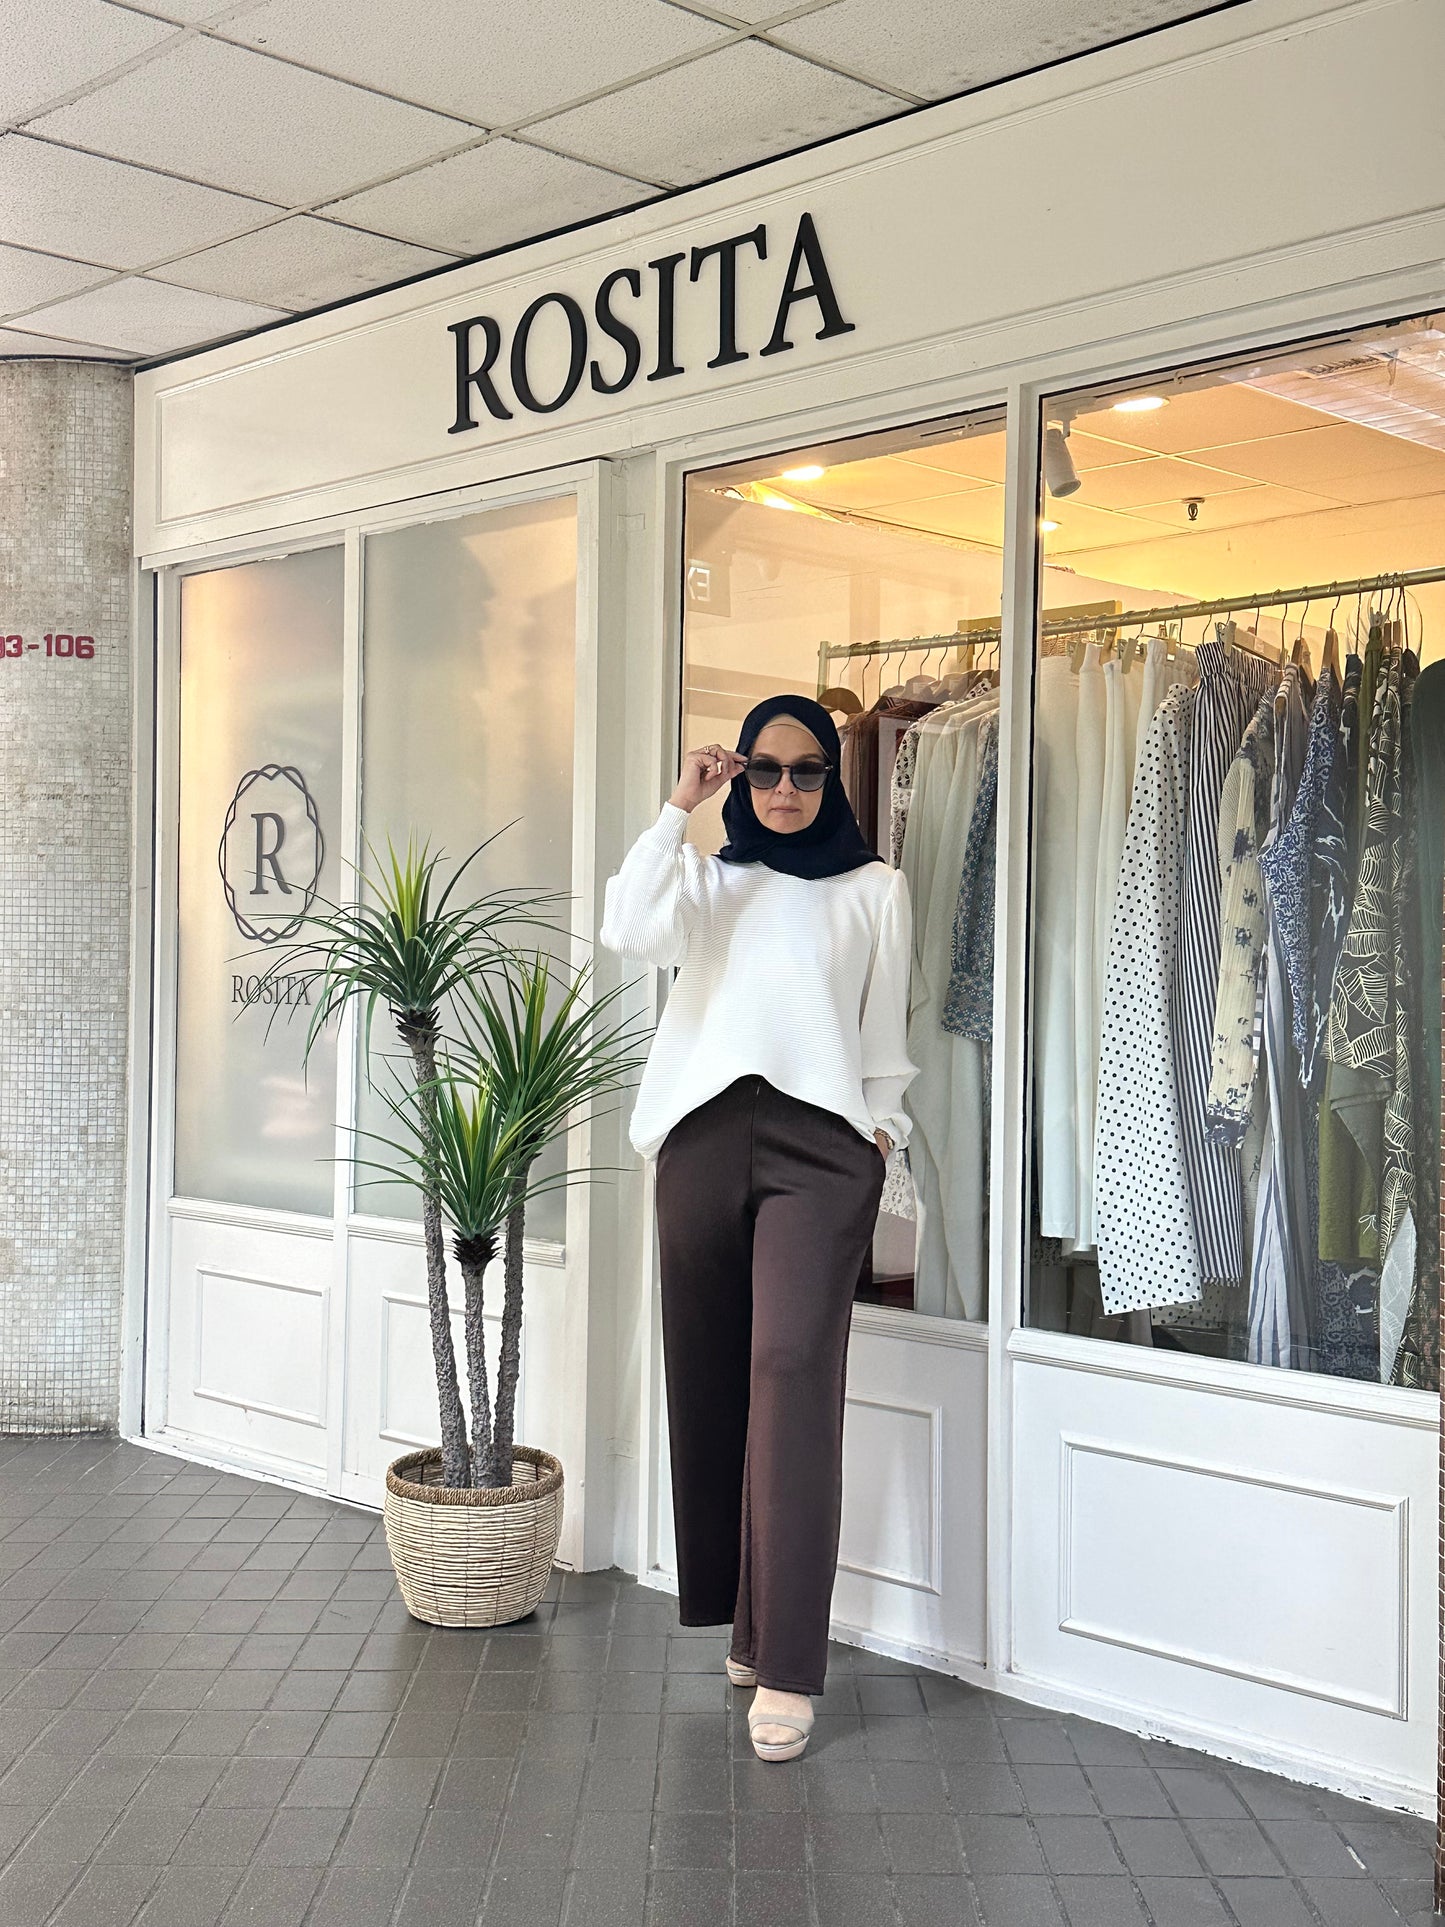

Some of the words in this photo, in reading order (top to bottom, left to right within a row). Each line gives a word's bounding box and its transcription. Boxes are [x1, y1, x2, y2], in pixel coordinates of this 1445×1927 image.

[447, 212, 856, 435] ROSITA
[249, 812, 292, 895] R
[231, 974, 311, 1005] ROSITA
